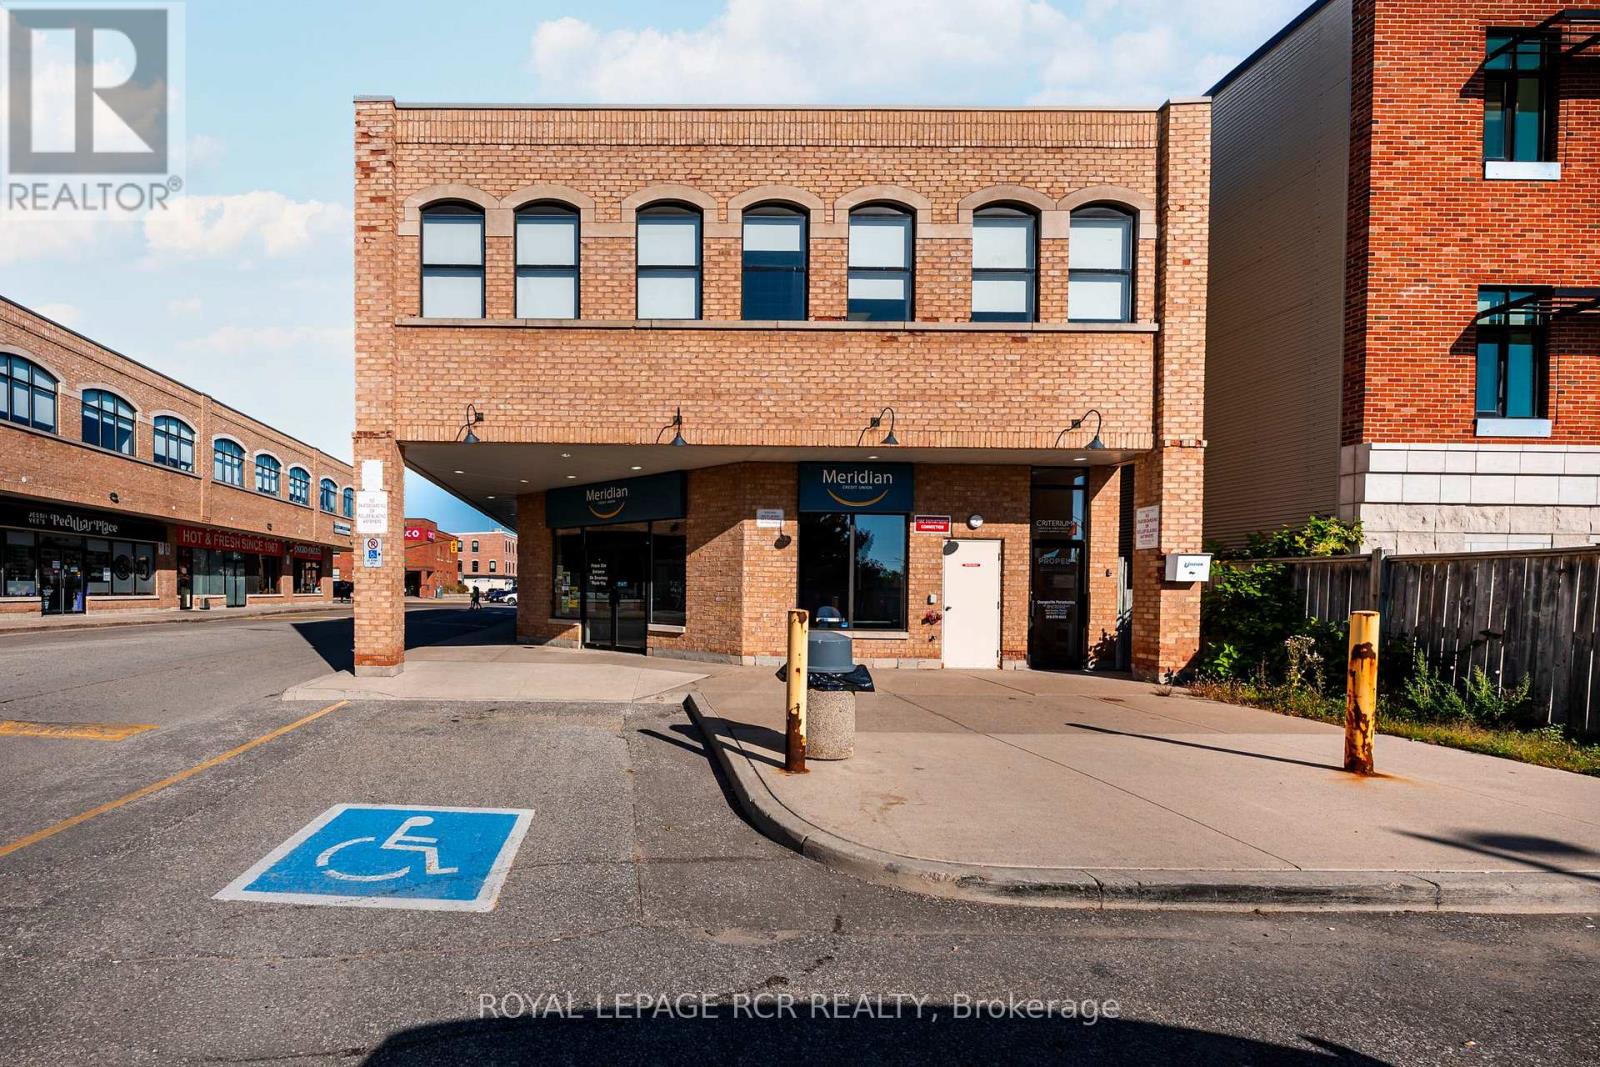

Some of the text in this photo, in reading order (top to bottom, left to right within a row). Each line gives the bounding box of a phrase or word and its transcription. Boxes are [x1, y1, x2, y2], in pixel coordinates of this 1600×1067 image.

[823, 470, 893, 484] Meridian
[586, 486, 628, 501] Meridian
[183, 529, 203, 544] HOT
[205, 533, 211, 545] &
[213, 534, 240, 549] FRESH
[241, 538, 264, 551] SINCE
